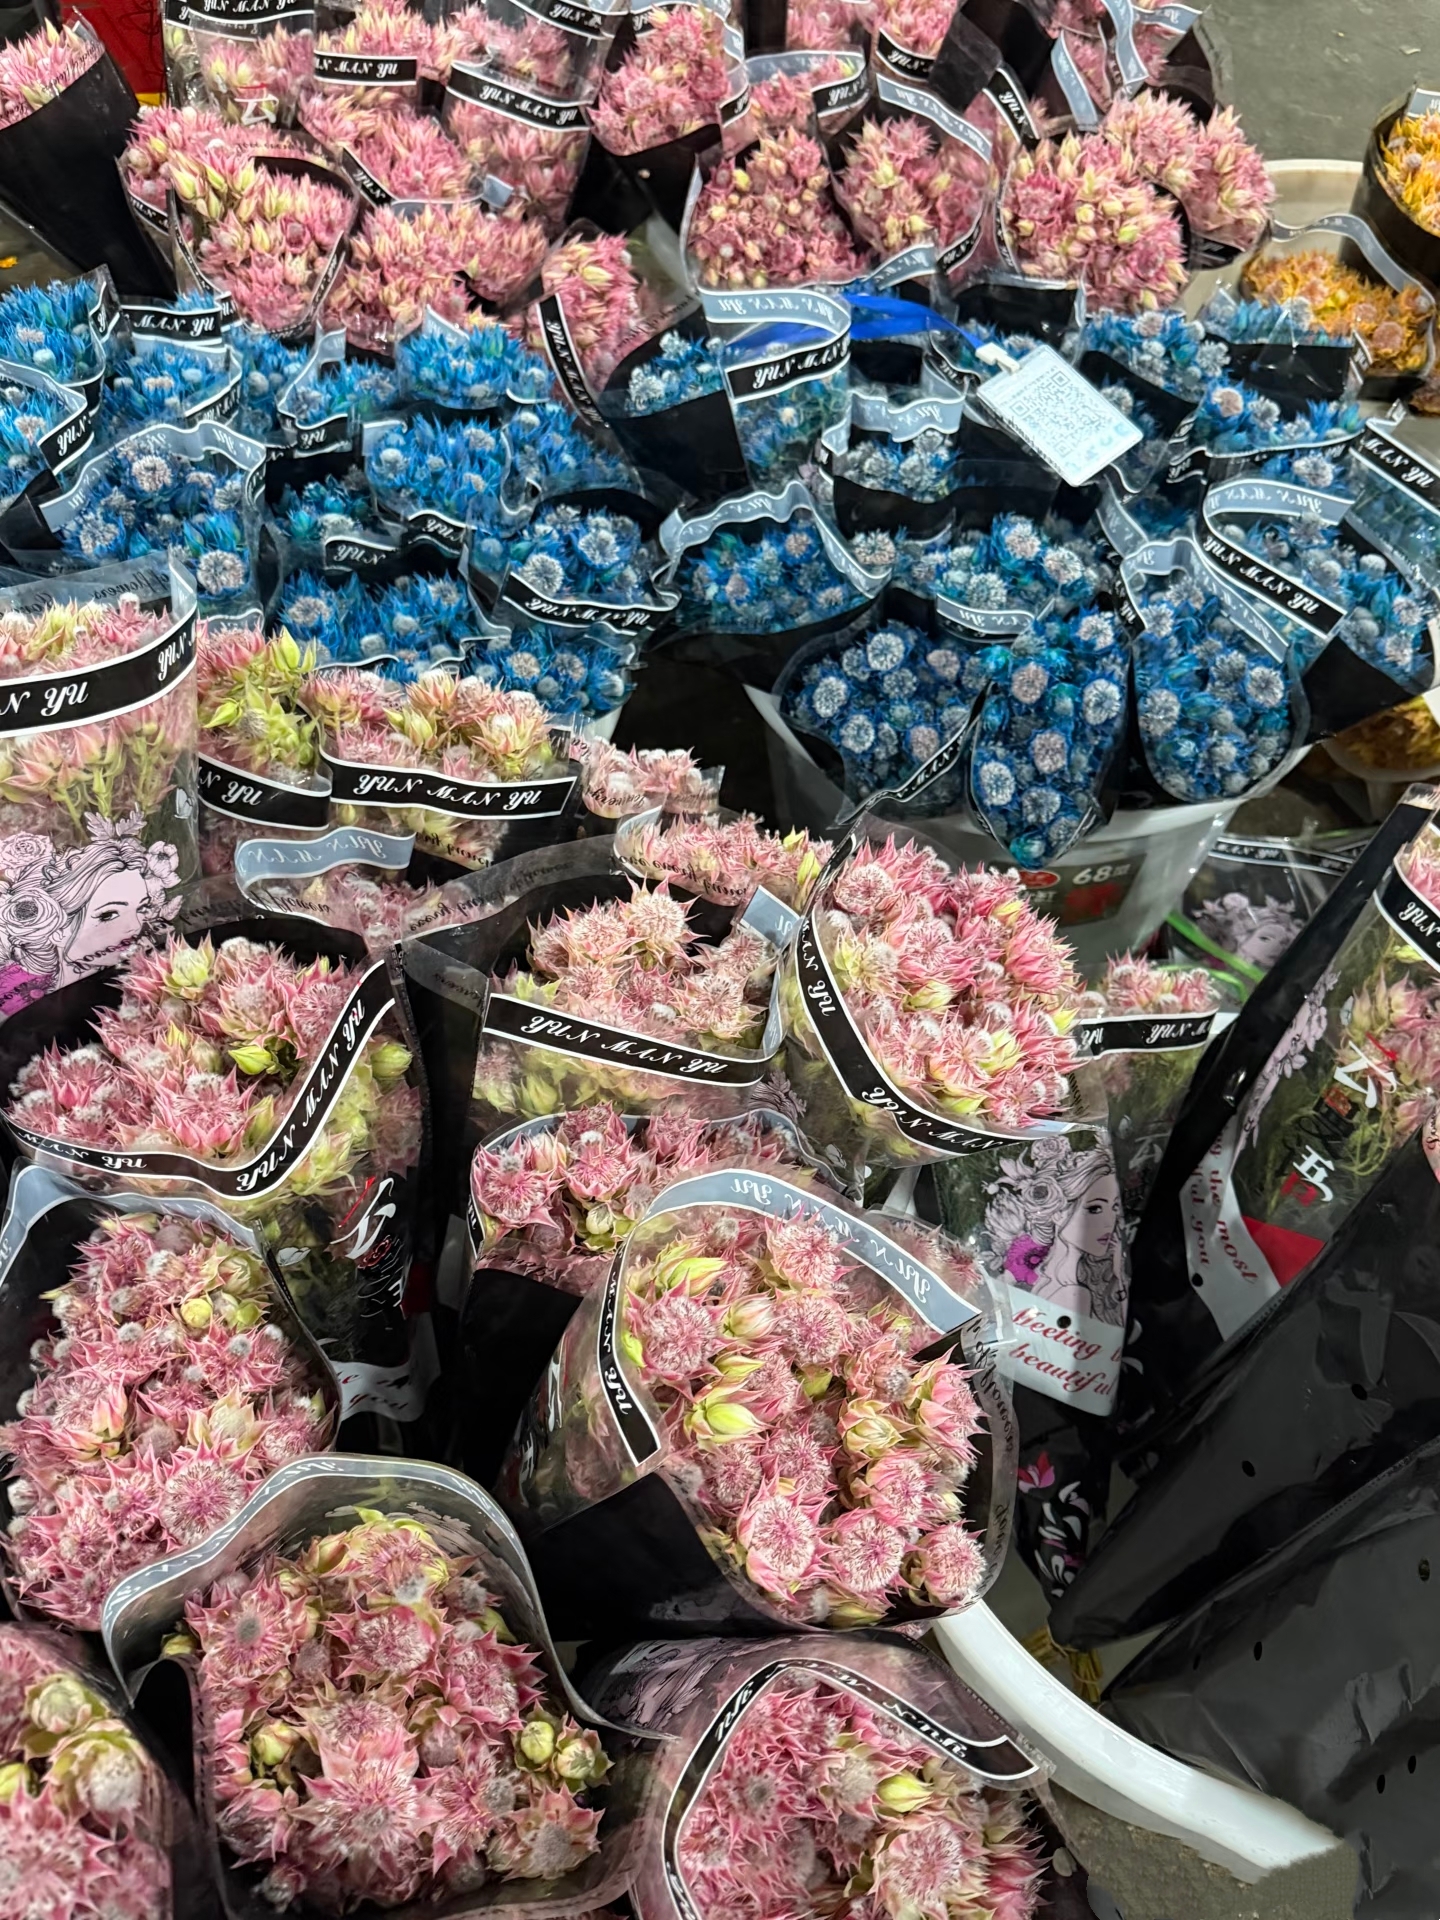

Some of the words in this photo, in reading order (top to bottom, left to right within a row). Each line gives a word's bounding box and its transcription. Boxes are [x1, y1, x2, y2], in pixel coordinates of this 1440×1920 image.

[334, 60, 373, 74] MAN
[376, 63, 398, 79] YU
[479, 85, 515, 105] YUN
[515, 96, 555, 119] MAN
[556, 106, 578, 125] YU
[133, 315, 187, 331] MAN
[190, 316, 214, 337] YU
[752, 358, 795, 389] YUN
[57, 415, 87, 456] YUN
[1401, 466, 1434, 488] YU
[333, 545, 386, 565] YUN
[1203, 536, 1241, 565] YUN
[1239, 565, 1291, 594] MAN
[1287, 592, 1320, 614] YU
[525, 597, 576, 618] YUN
[622, 611, 650, 627] YU
[157, 632, 186, 681] YUN
[41, 681, 89, 717] YU
[217, 781, 263, 807] YU
[352, 774, 423, 796] YUN
[427, 784, 501, 807] MAN
[501, 788, 540, 813] YU
[1072, 865, 1113, 885] 68
[807, 979, 837, 1018] YU
[521, 1014, 601, 1046] YUN
[601, 1039, 682, 1065] MAN
[680, 1057, 729, 1075] YU
[1146, 1021, 1192, 1046] YUN
[237, 1125, 296, 1191] YUN
[302, 1054, 340, 1129] MAN
[342, 998, 366, 1052] YU
[862, 1087, 932, 1130] YUN
[928, 1126, 1005, 1150] MAN
[101, 1154, 147, 1171] YU
[1012, 1307, 1103, 1360] Meeting
[603, 1365, 629, 1416] YU
[715, 1682, 755, 1742] YU
[884, 1697, 967, 1758] YUN
